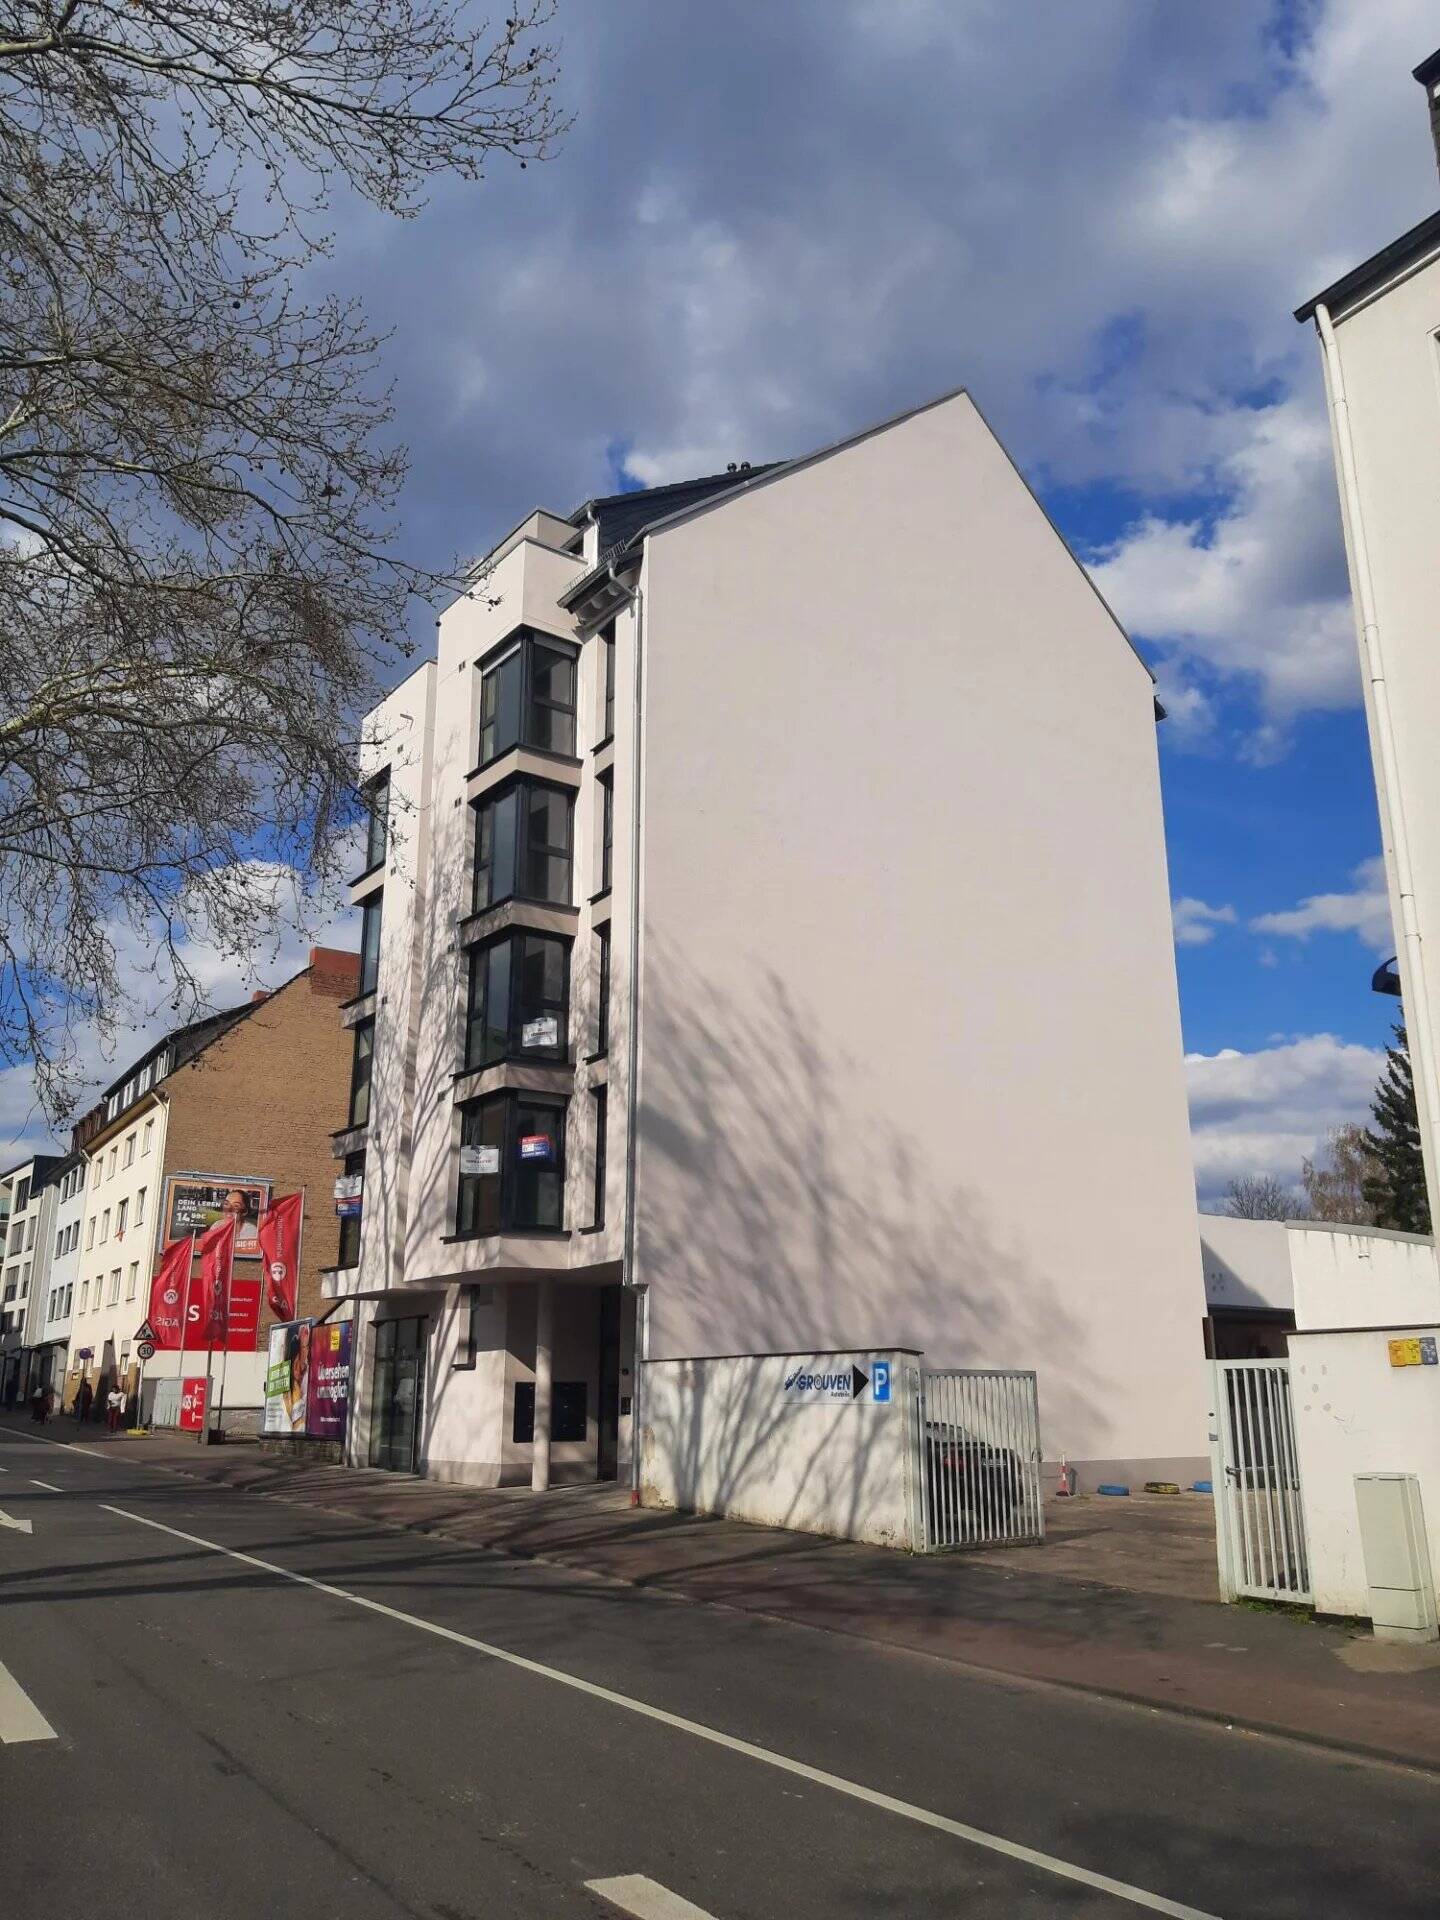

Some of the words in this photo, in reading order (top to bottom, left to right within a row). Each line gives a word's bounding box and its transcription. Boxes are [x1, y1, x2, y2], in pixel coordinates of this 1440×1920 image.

[198, 1200, 221, 1208] LEBEN
[141, 1345, 152, 1355] 30
[798, 1374, 851, 1391] GROUVEN
[875, 1368, 887, 1396] P
